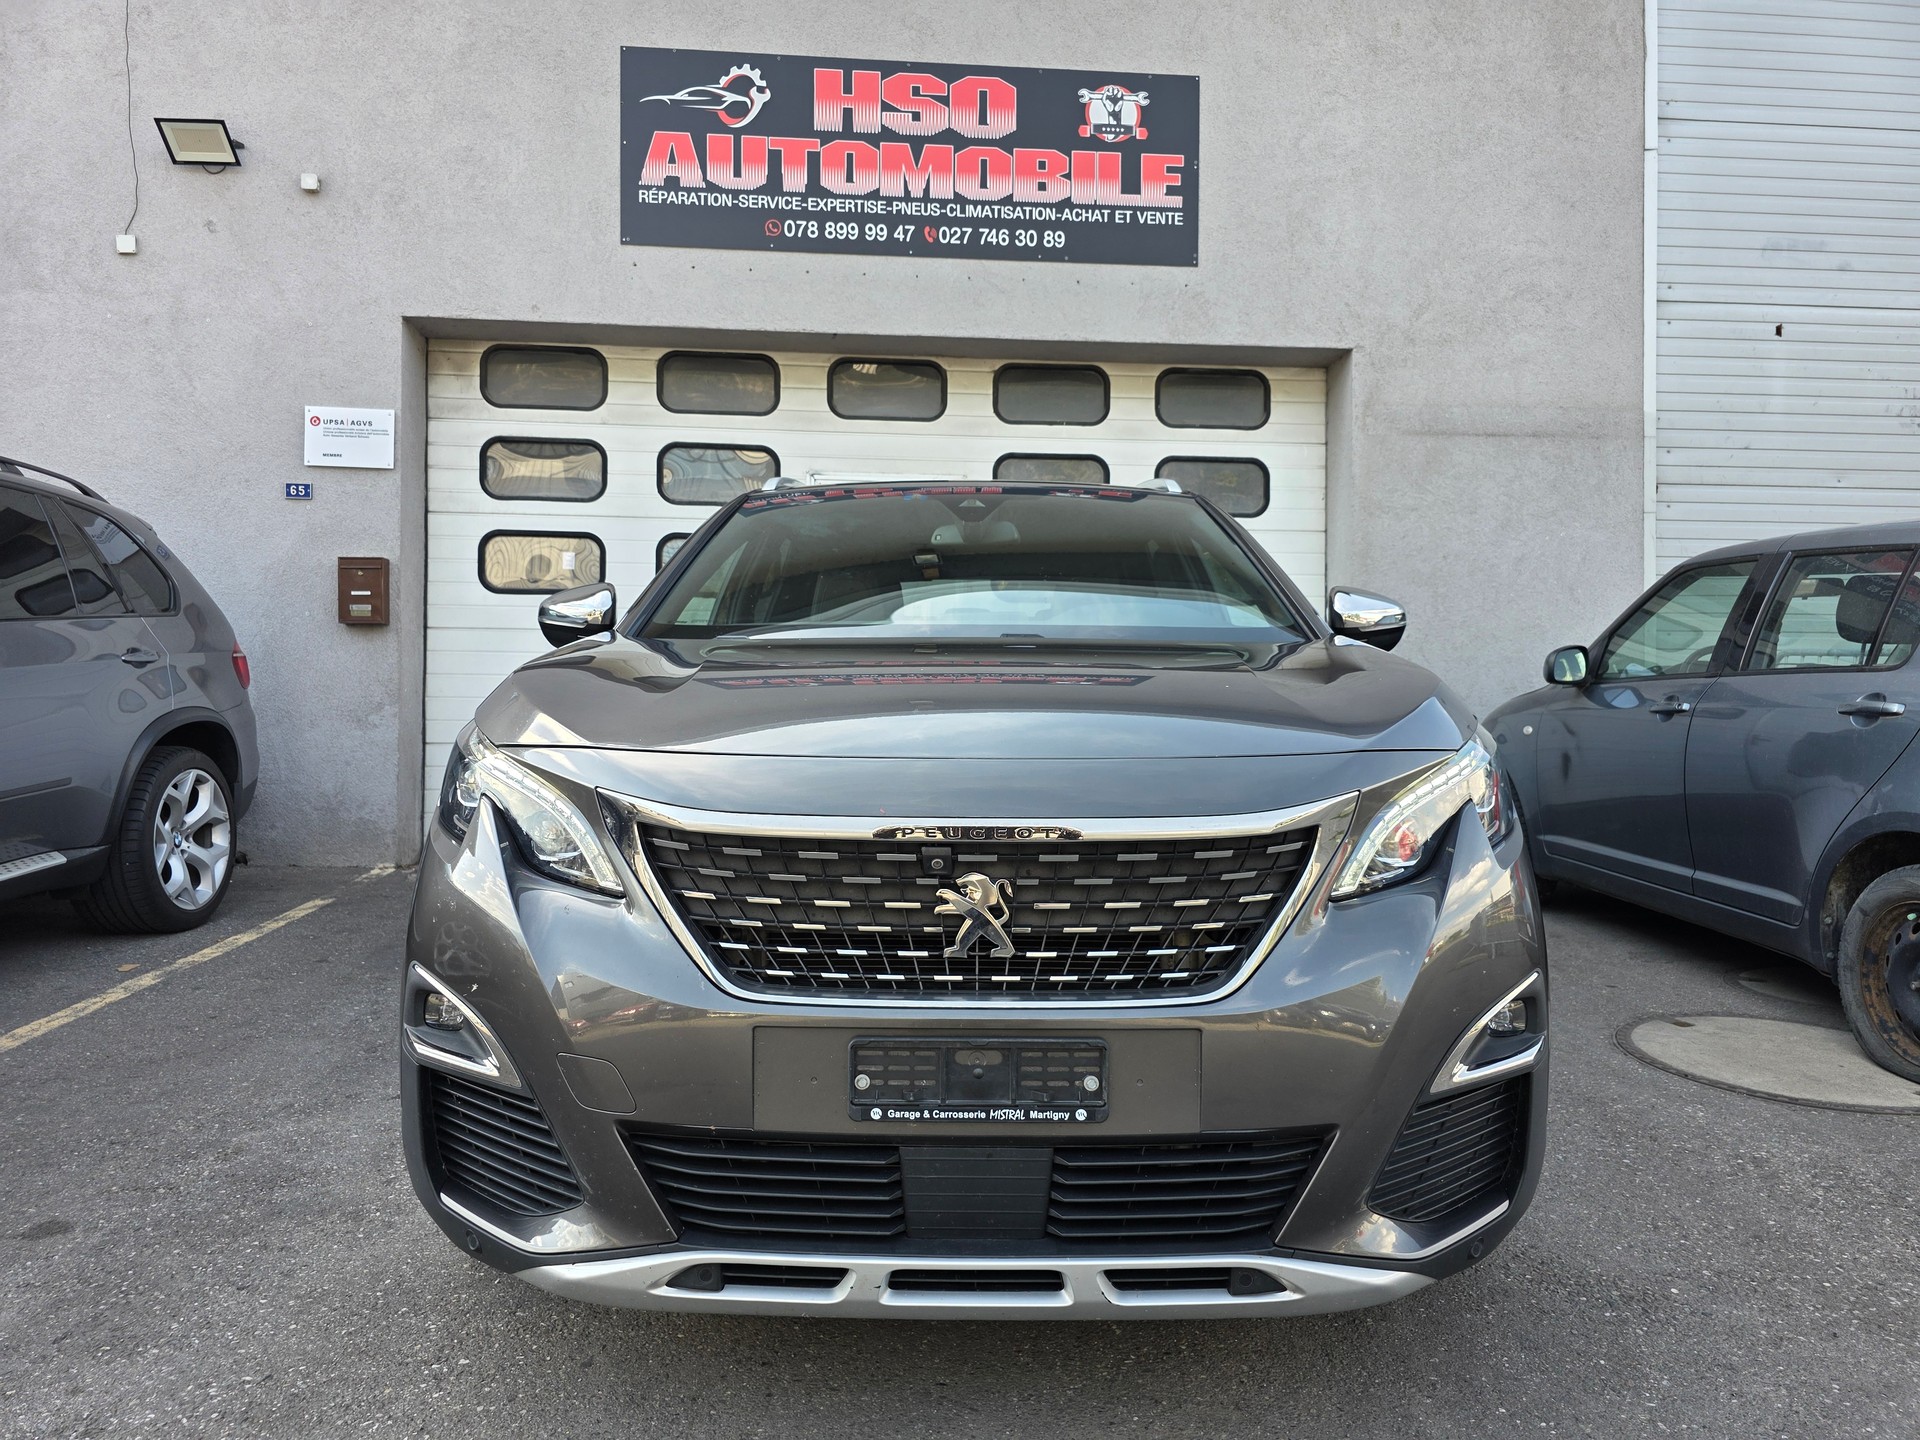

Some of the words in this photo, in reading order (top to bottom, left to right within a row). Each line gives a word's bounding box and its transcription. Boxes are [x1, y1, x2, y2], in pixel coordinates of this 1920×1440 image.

[814, 67, 1017, 140] HSO
[639, 130, 1185, 208] AUTOMOBILE
[1114, 210, 1133, 223] ET
[1137, 211, 1184, 226] VENTE
[783, 219, 819, 238] 078
[824, 221, 859, 240] 899
[864, 223, 888, 242] 99
[893, 224, 916, 242] 47
[938, 226, 973, 244] 027
[978, 227, 1010, 246] 746
[1014, 229, 1038, 247] 30
[1042, 230, 1066, 248] 89
[322, 418, 345, 426] UPSA
[289, 485, 306, 496] 65
[901, 826, 1057, 840] PEUGEOT
[887, 1109, 921, 1120] Garage
[922, 1109, 931, 1118] &
[932, 1109, 987, 1119] Carrosserie
[989, 1108, 1026, 1120] MISTRAL
[1029, 1109, 1071, 1121] Martigny
